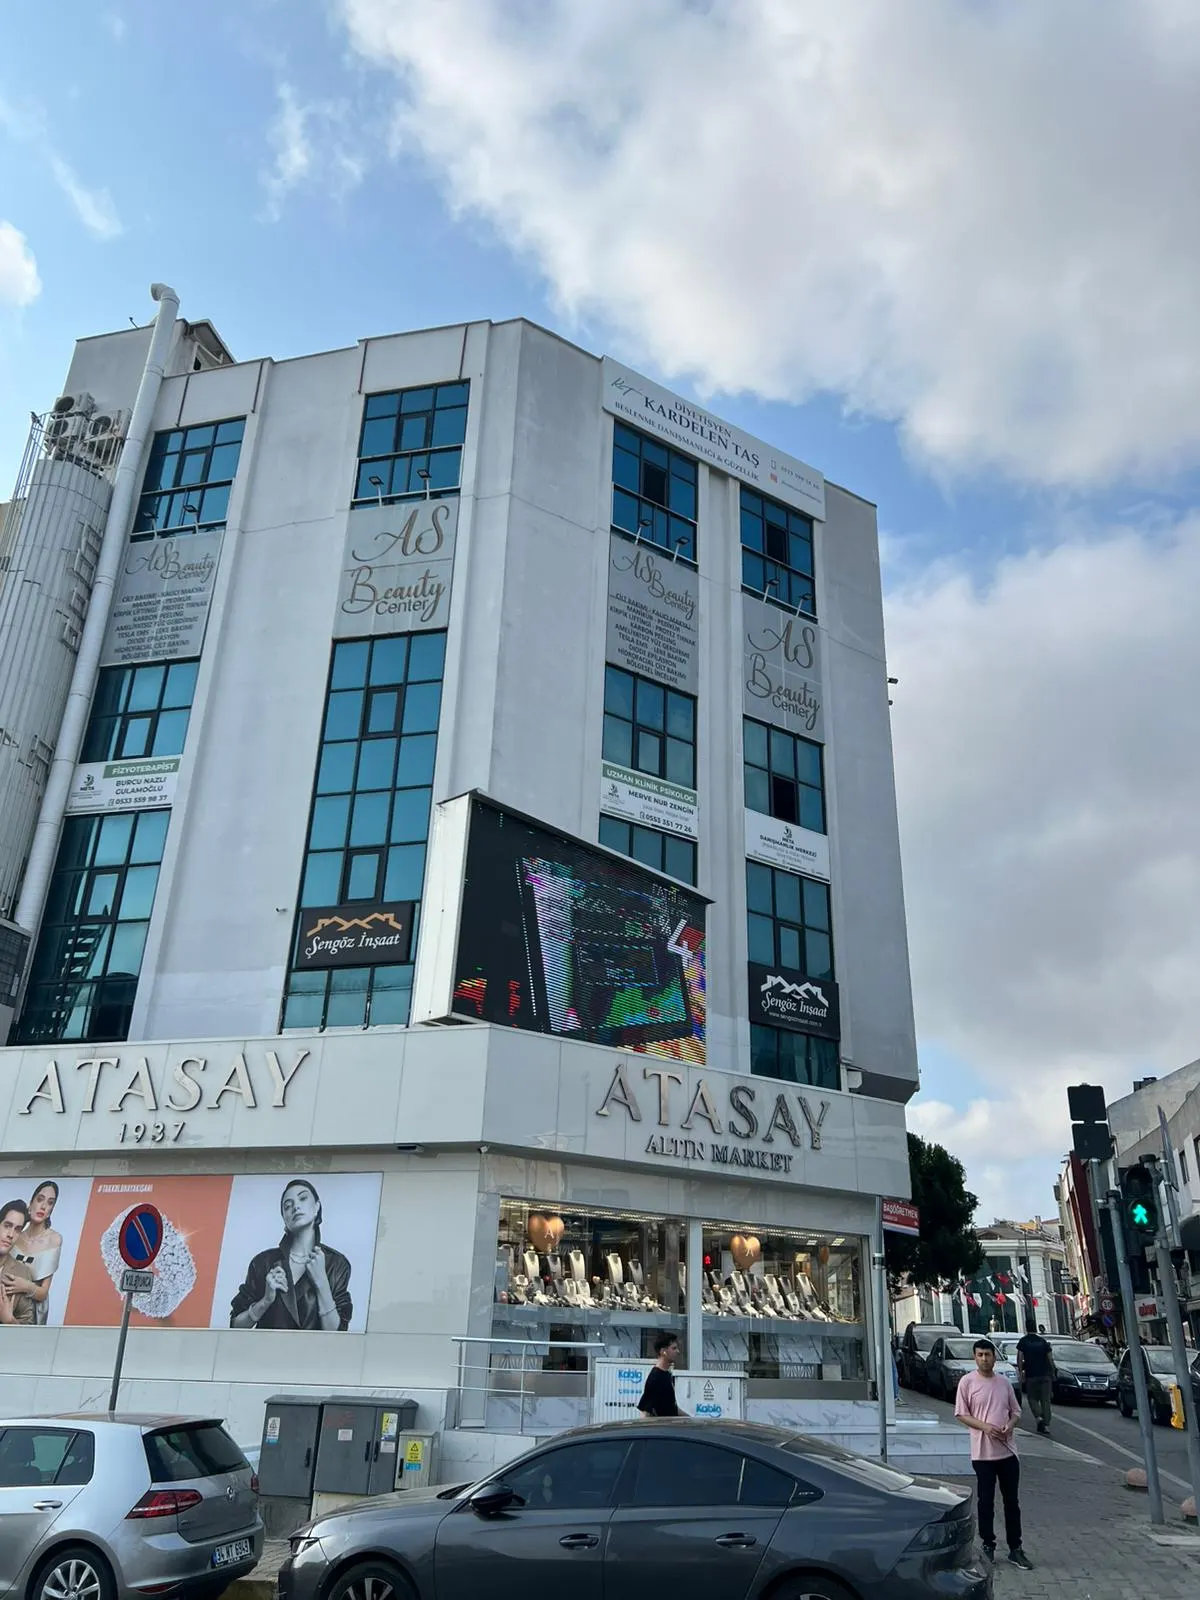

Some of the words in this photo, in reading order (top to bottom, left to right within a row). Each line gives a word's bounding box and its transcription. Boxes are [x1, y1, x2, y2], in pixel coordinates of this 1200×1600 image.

[644, 395, 728, 450] KARDELEN
[731, 441, 759, 470] TAŞ
[352, 505, 450, 561] AS
[341, 565, 446, 622] Beauty
[375, 600, 429, 615] Center
[747, 620, 815, 669] AS
[746, 653, 820, 731] Beauty
[772, 697, 811, 719] Center
[115, 778, 142, 786] BURCU
[607, 769, 633, 782] UZMAN
[634, 777, 657, 791] KLİNİK
[660, 785, 693, 802] PSİKOLOG
[628, 789, 651, 802] MERVE
[653, 797, 667, 807] NUR
[305, 935, 356, 959] Şengöz
[358, 931, 401, 949] İnşaat
[761, 991, 797, 1012] Şengöz
[799, 998, 827, 1018] İnşaat
[17, 1050, 311, 1115] ATASAY
[596, 1064, 831, 1150] ATASAY
[119, 1121, 186, 1143] 1937
[645, 1133, 705, 1161] ALTIN
[711, 1143, 793, 1174] MARKET
